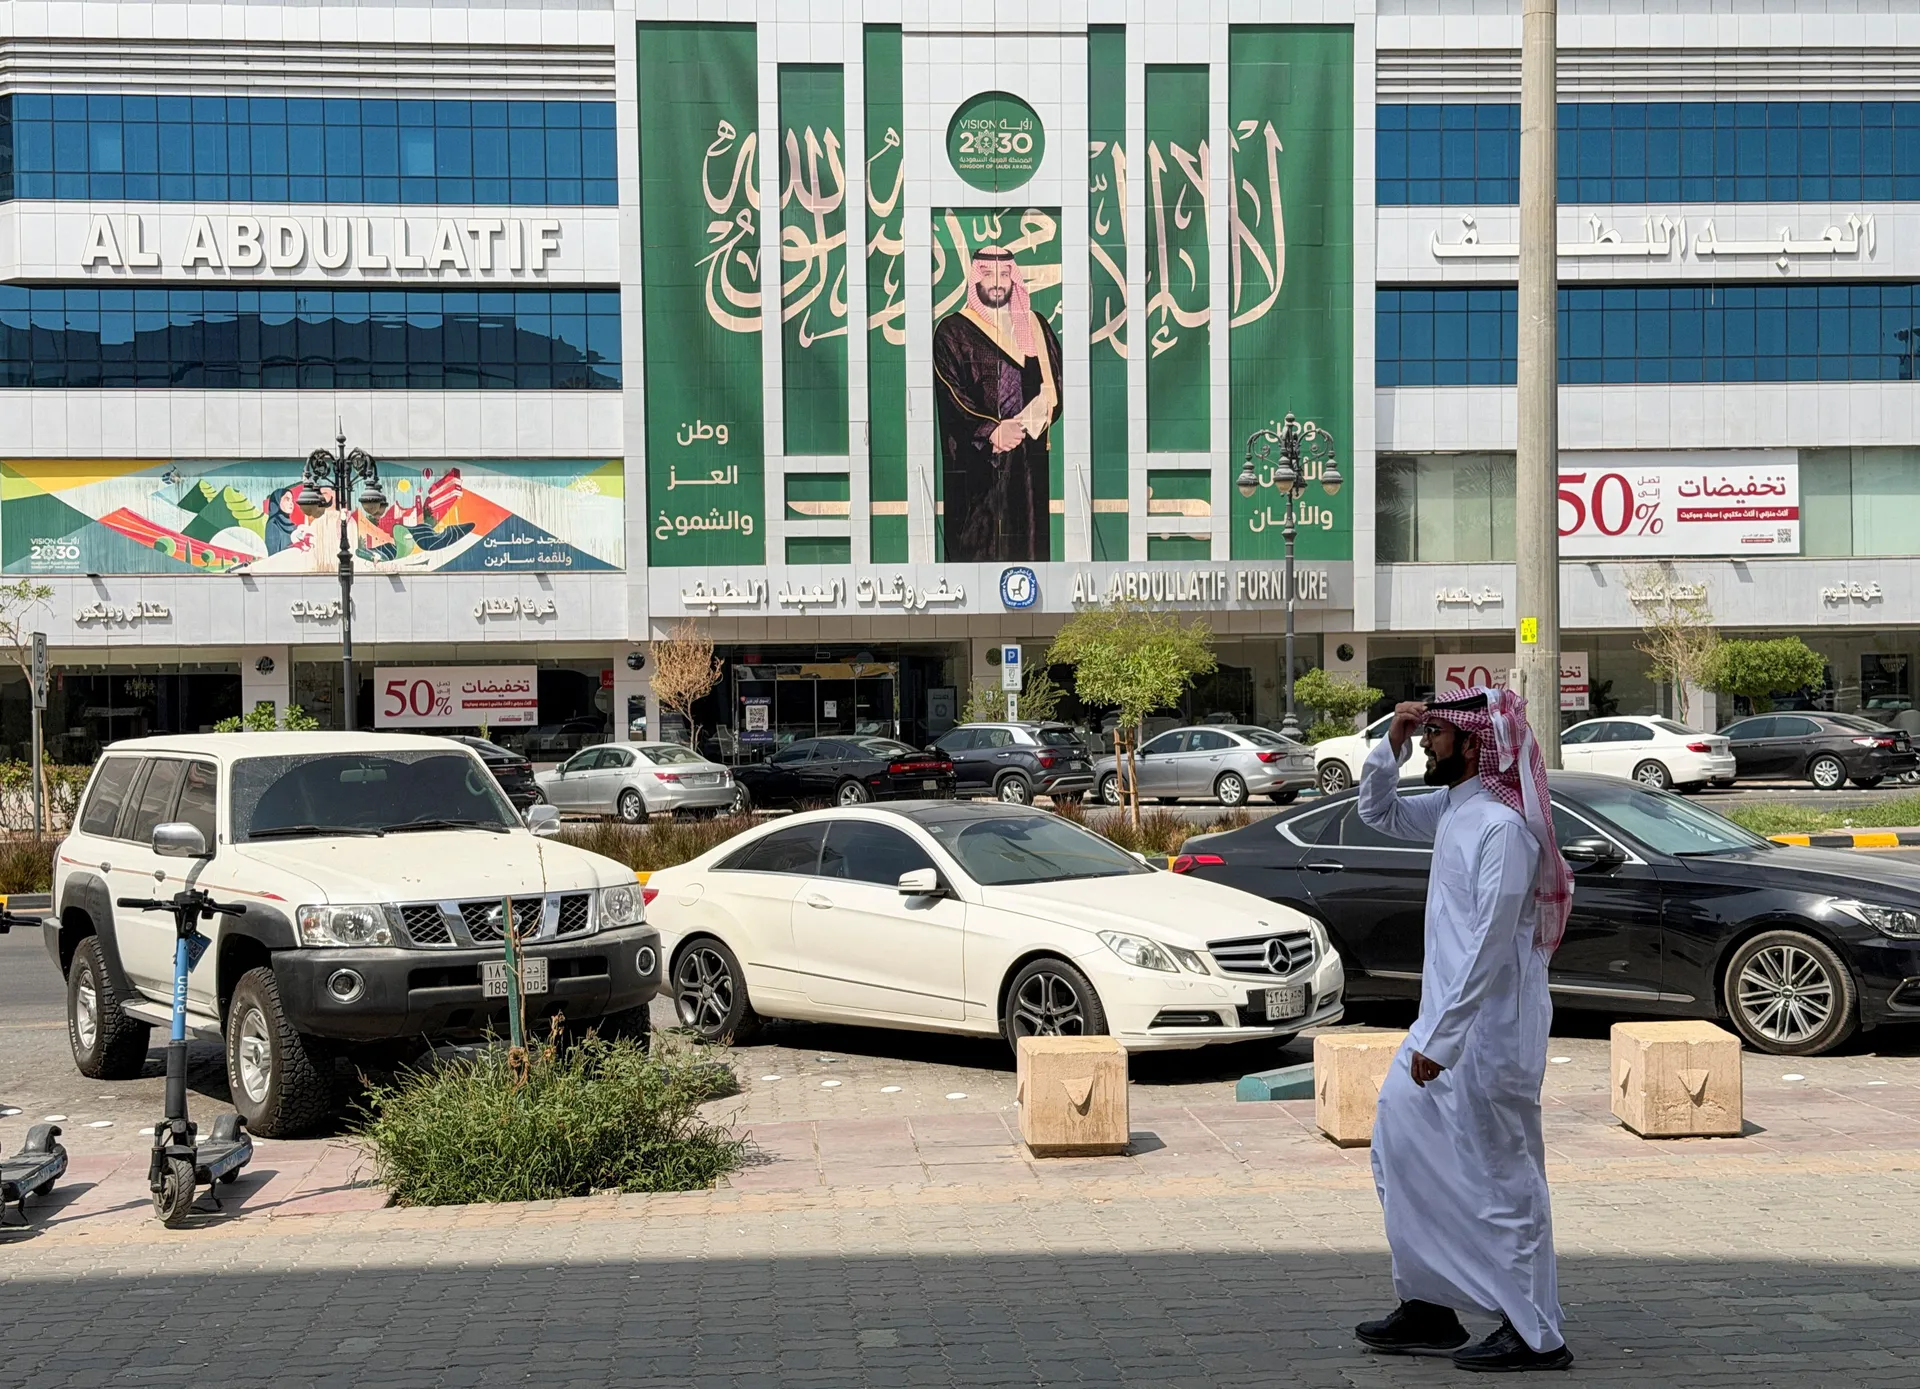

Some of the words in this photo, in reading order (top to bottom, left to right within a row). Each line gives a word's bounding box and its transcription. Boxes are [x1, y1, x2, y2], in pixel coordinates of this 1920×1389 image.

[959, 119, 997, 130] VISION
[999, 117, 1033, 131] رؤية
[81, 213, 161, 268] AL
[181, 214, 564, 274] ABDULLATIF
[1431, 212, 1688, 258] اللطف
[1695, 212, 1877, 270] العبد
[676, 419, 729, 446] وطن
[667, 464, 738, 491] العز
[1258, 456, 1324, 488] الأن
[1637, 475, 1661, 487] تصل
[1678, 475, 1787, 505] تخفيضات
[655, 507, 754, 540] والشموخ
[30, 537, 56, 545] VISION
[483, 533, 535, 548] حاملين
[483, 552, 535, 567] سائرين
[537, 552, 573, 567] وللقمة
[681, 579, 769, 612] اللطيف
[778, 577, 845, 610] العبد
[856, 573, 965, 609] مفروشات
[1071, 571, 1099, 603] AL
[1112, 570, 1226, 602] ABDULLATIF
[1007, 650, 1016, 662] P
[461, 679, 531, 698] تخفيضات
